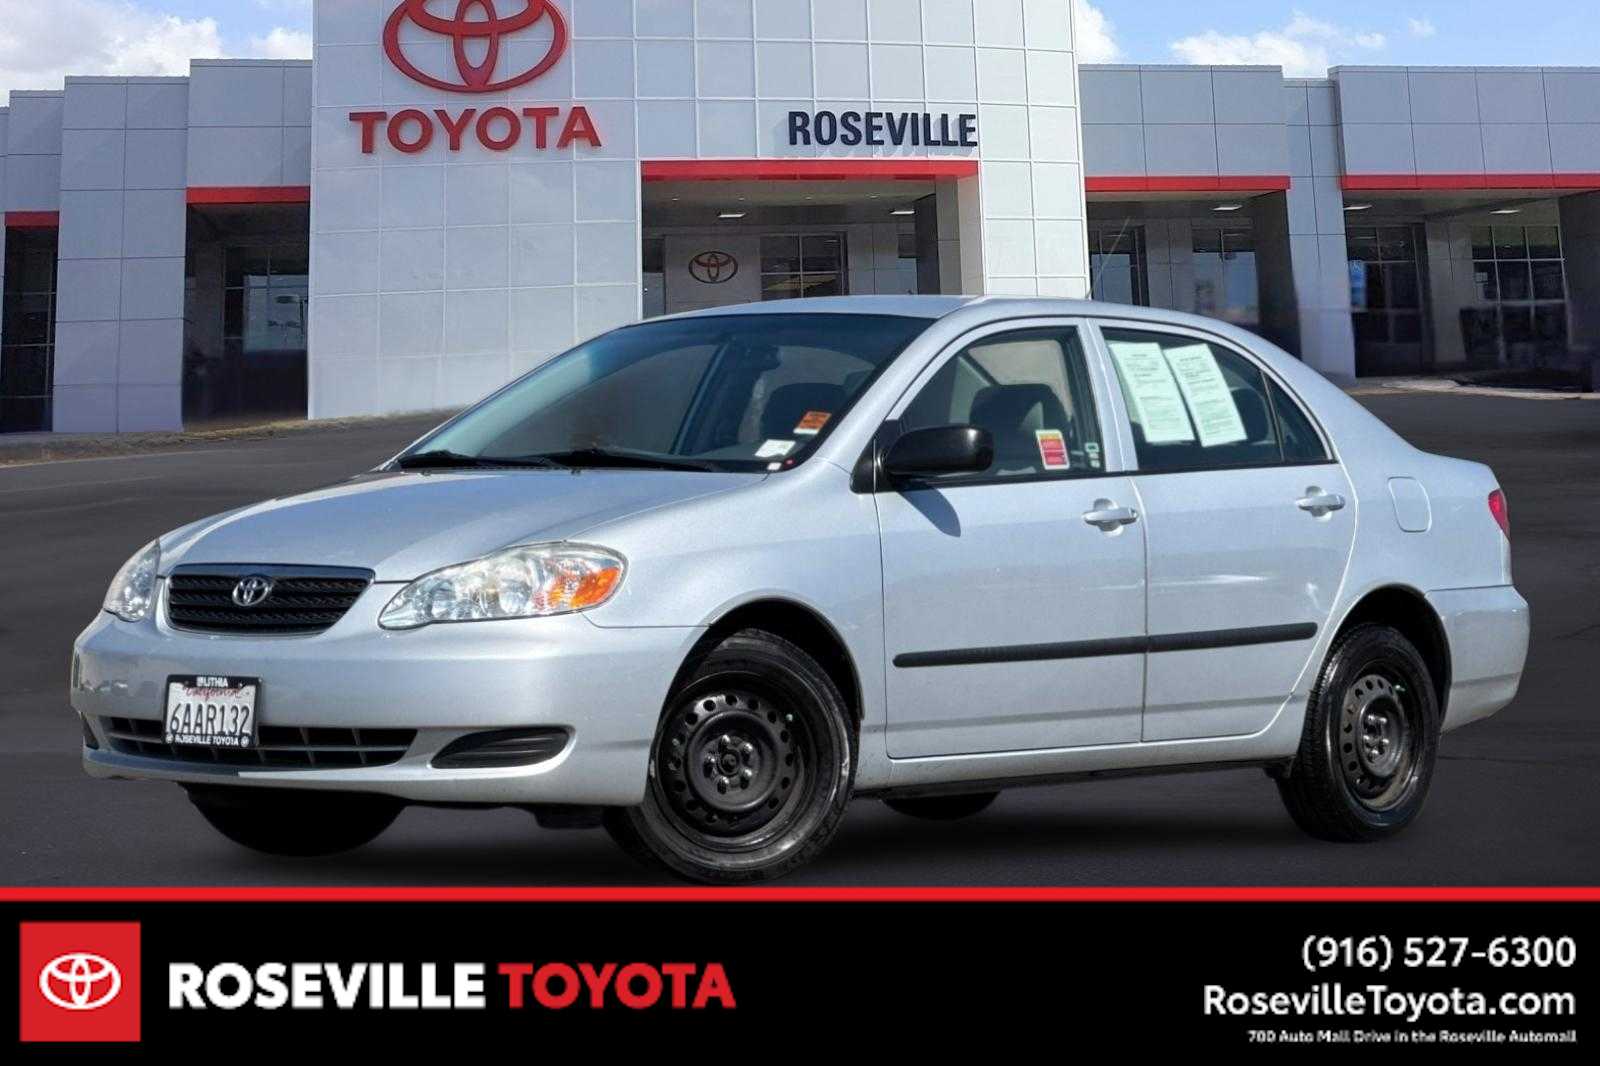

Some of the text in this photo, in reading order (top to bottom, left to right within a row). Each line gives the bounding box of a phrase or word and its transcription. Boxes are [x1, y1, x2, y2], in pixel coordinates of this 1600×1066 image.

[350, 106, 603, 153] TOYOTA
[789, 111, 978, 147] ROSEVILLE
[169, 703, 251, 736] 6AAR132
[212, 736, 239, 746] TOYOTA
